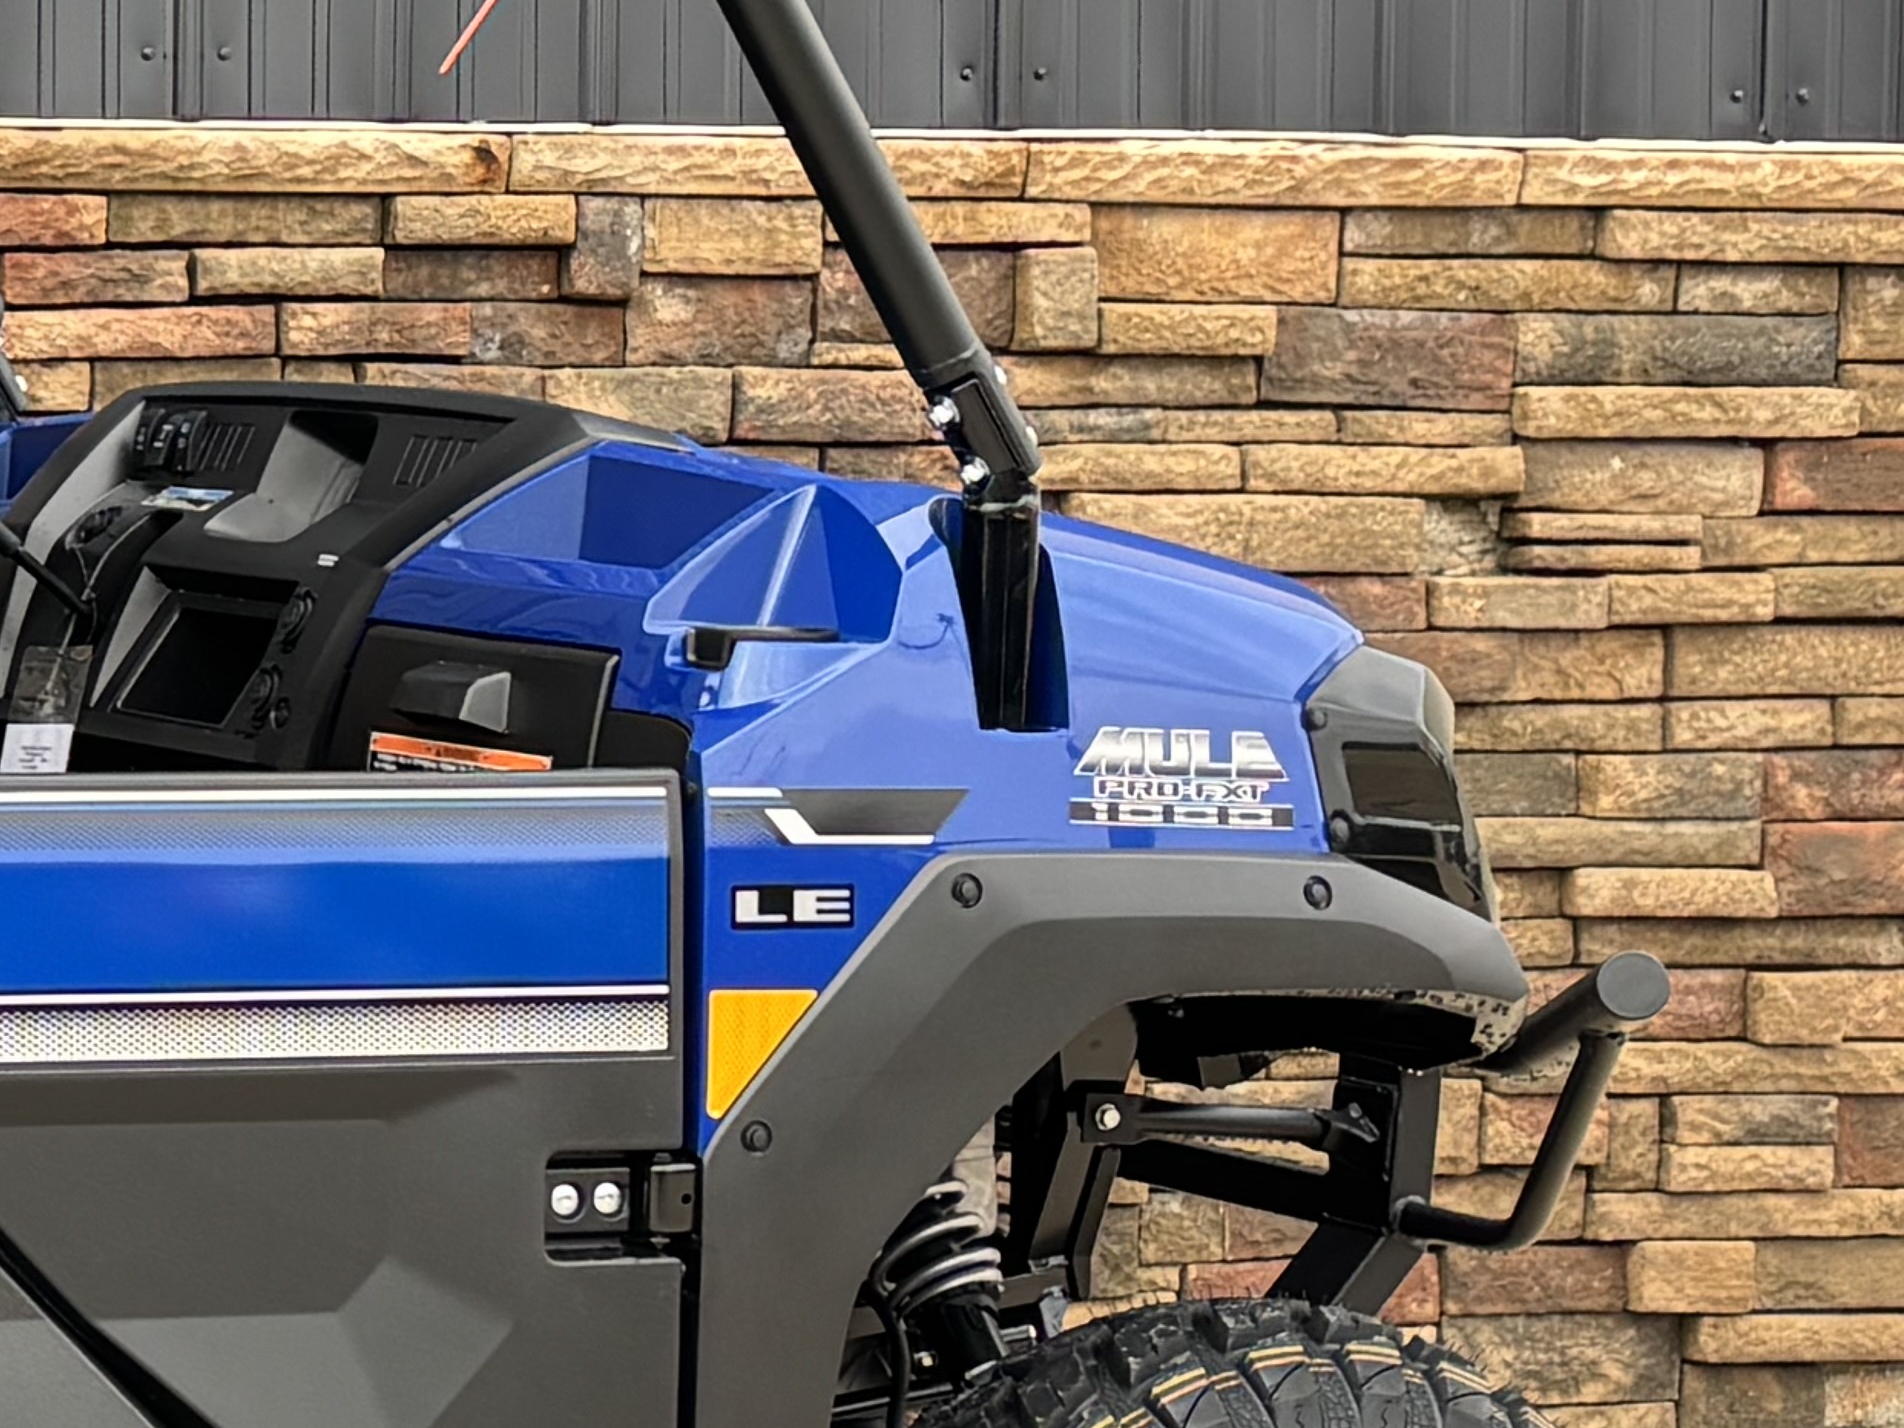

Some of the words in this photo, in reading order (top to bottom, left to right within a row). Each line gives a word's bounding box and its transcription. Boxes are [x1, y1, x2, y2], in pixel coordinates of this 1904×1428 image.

[1073, 726, 1290, 781] MULE
[1089, 801, 1275, 826] 1000
[735, 889, 851, 923] LE
